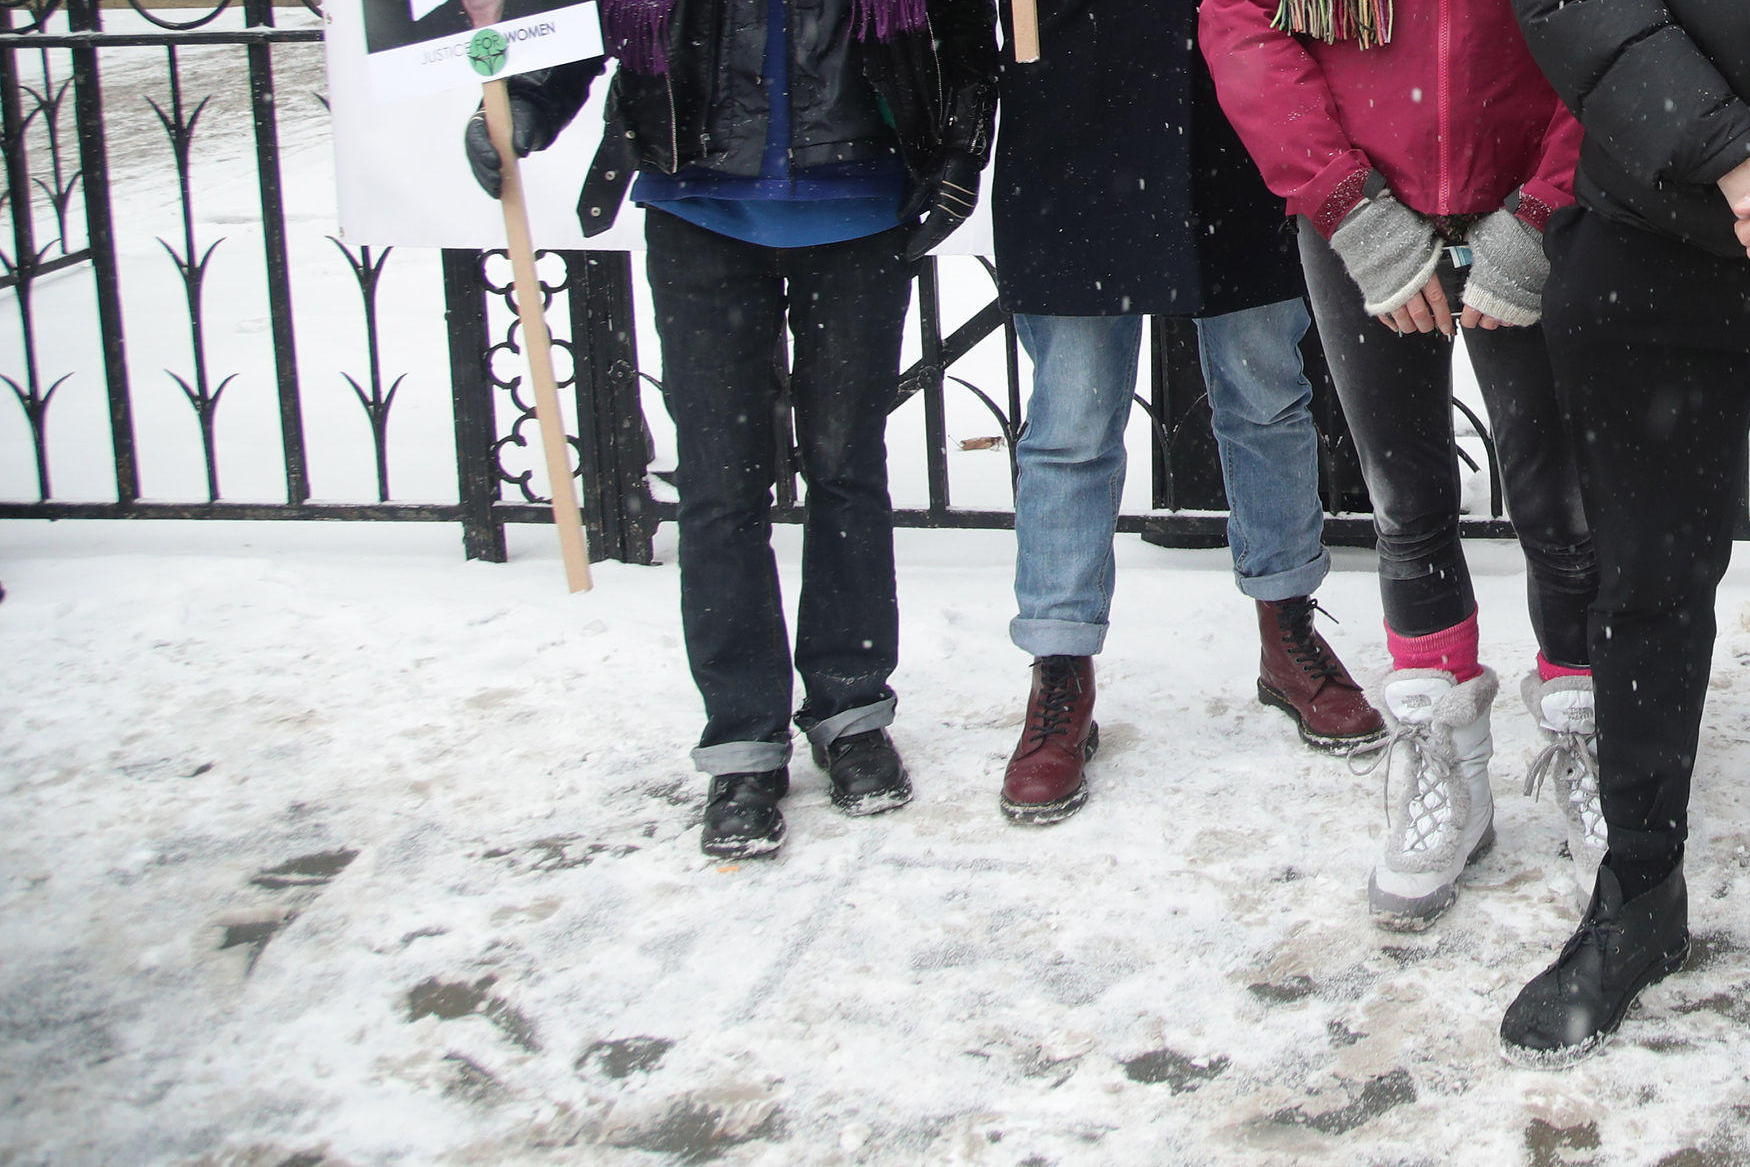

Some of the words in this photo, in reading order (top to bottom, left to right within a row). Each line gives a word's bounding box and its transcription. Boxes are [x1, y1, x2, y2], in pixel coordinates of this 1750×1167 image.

[421, 40, 471, 65] JUSTICE
[475, 34, 501, 51] FOR
[504, 22, 556, 44] WOMEN
